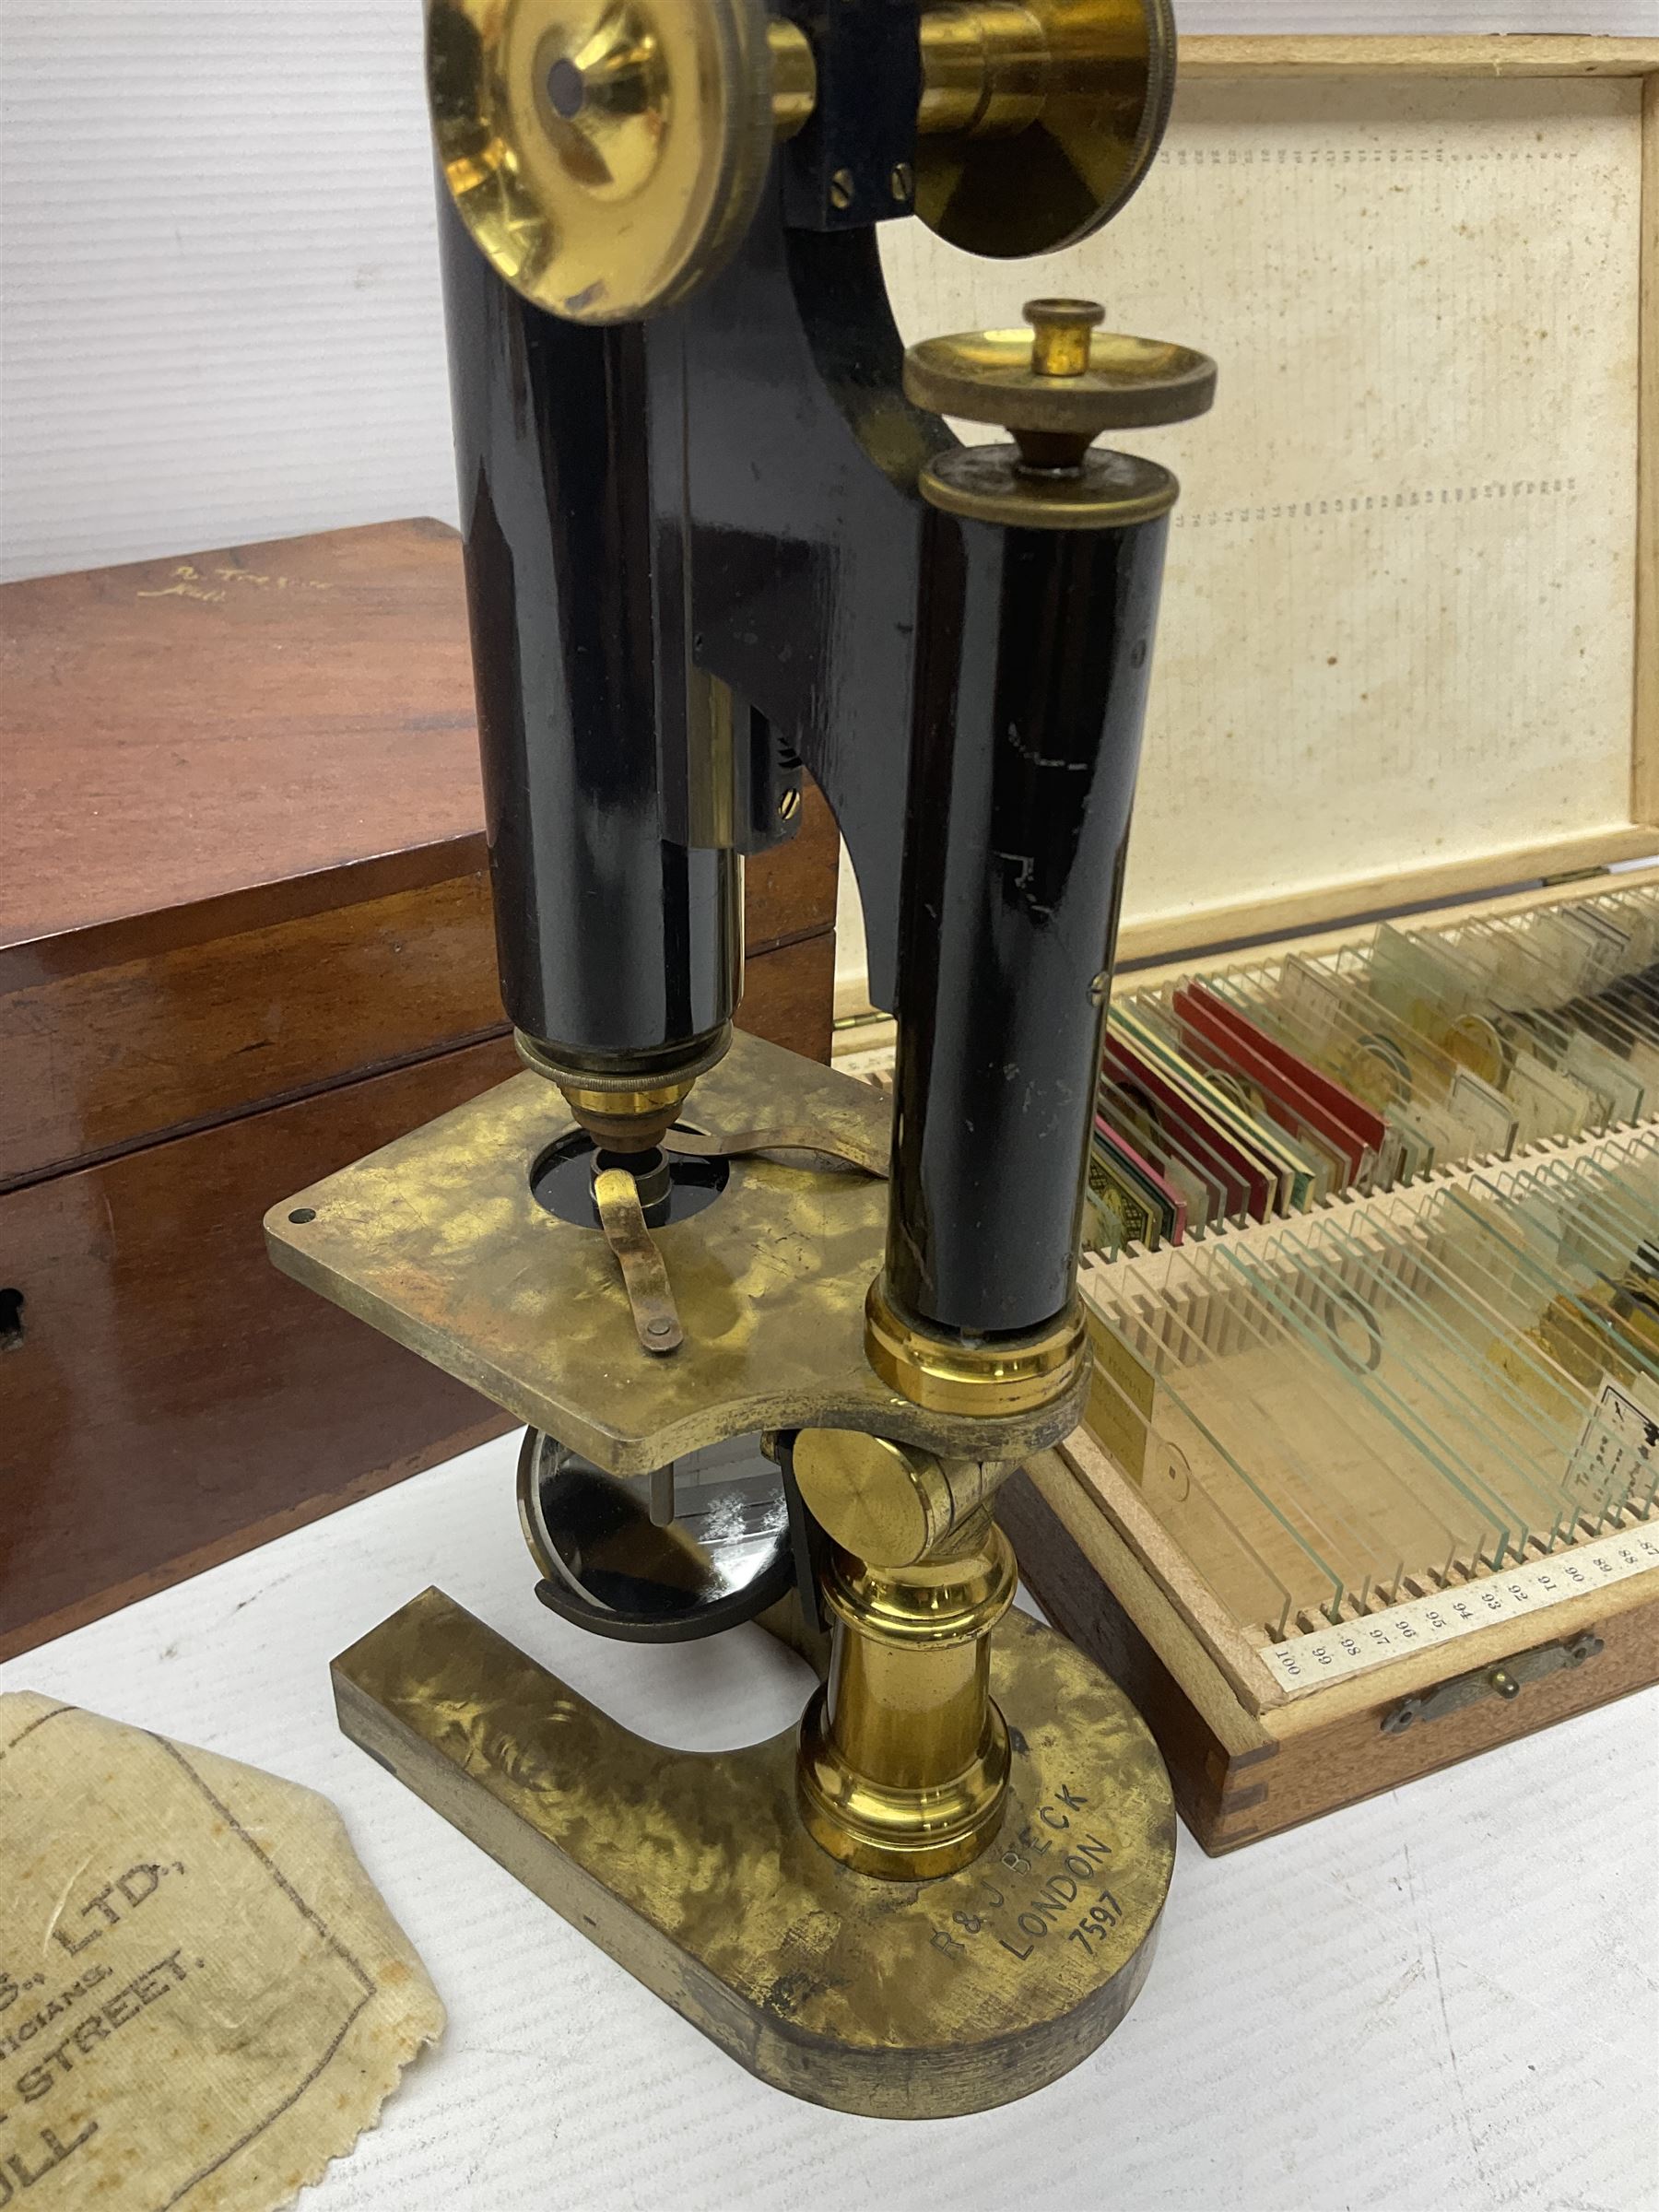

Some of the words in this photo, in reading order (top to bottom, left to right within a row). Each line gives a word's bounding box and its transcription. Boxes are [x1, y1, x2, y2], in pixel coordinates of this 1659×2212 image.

[1276, 1651, 1300, 1676] 100
[1312, 1648, 1332, 1665] 99
[1341, 1638, 1360, 1656] 98
[1370, 1629, 1390, 1646] 97
[1395, 1620, 1417, 1639] 96
[1426, 1611, 1446, 1629] 95
[1453, 1602, 1474, 1620] 94
[1481, 1593, 1501, 1610] 93
[1508, 1584, 1528, 1602] 92
[1537, 1575, 1557, 1592] 91
[1564, 1566, 1584, 1583] 90
[1593, 1558, 1613, 1572] 89
[1618, 1549, 1639, 1564] 88
[999, 1833, 1112, 1961] LONDON
[1067, 1889, 1124, 1956] 7597
